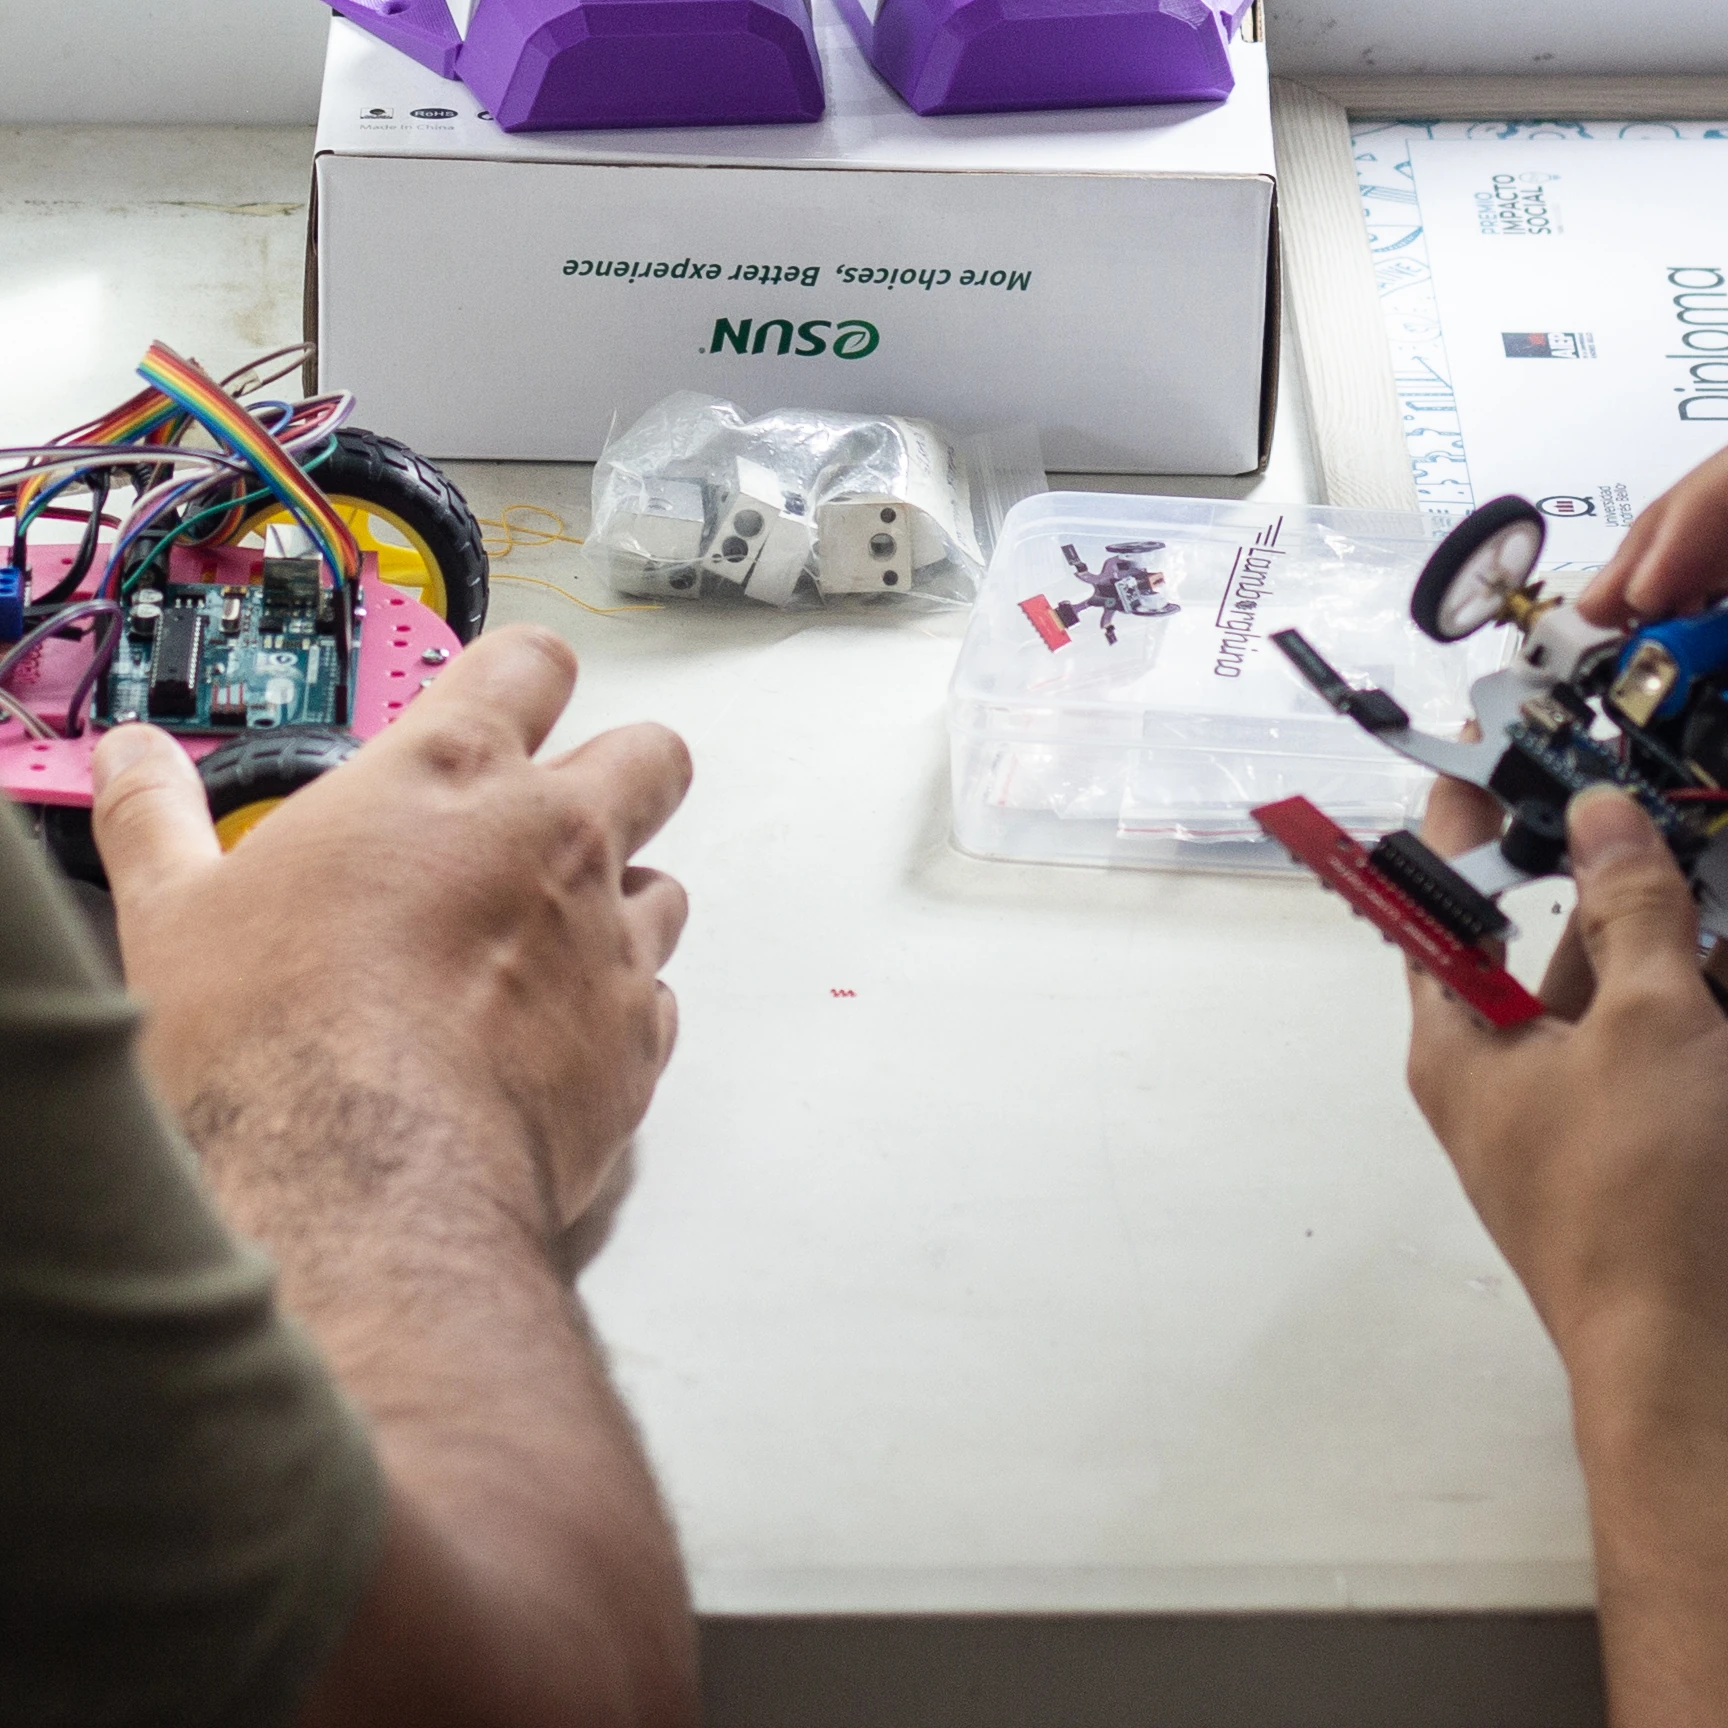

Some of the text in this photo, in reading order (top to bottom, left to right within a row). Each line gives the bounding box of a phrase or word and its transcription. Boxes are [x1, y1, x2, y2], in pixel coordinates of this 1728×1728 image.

[1474, 191, 1500, 234] PREMIO
[1492, 174, 1526, 234] IMPACTO
[1520, 185, 1551, 234] SOCIAL
[562, 258, 1032, 291] More choices, Better experience
[1597, 485, 1619, 528] Universidad
